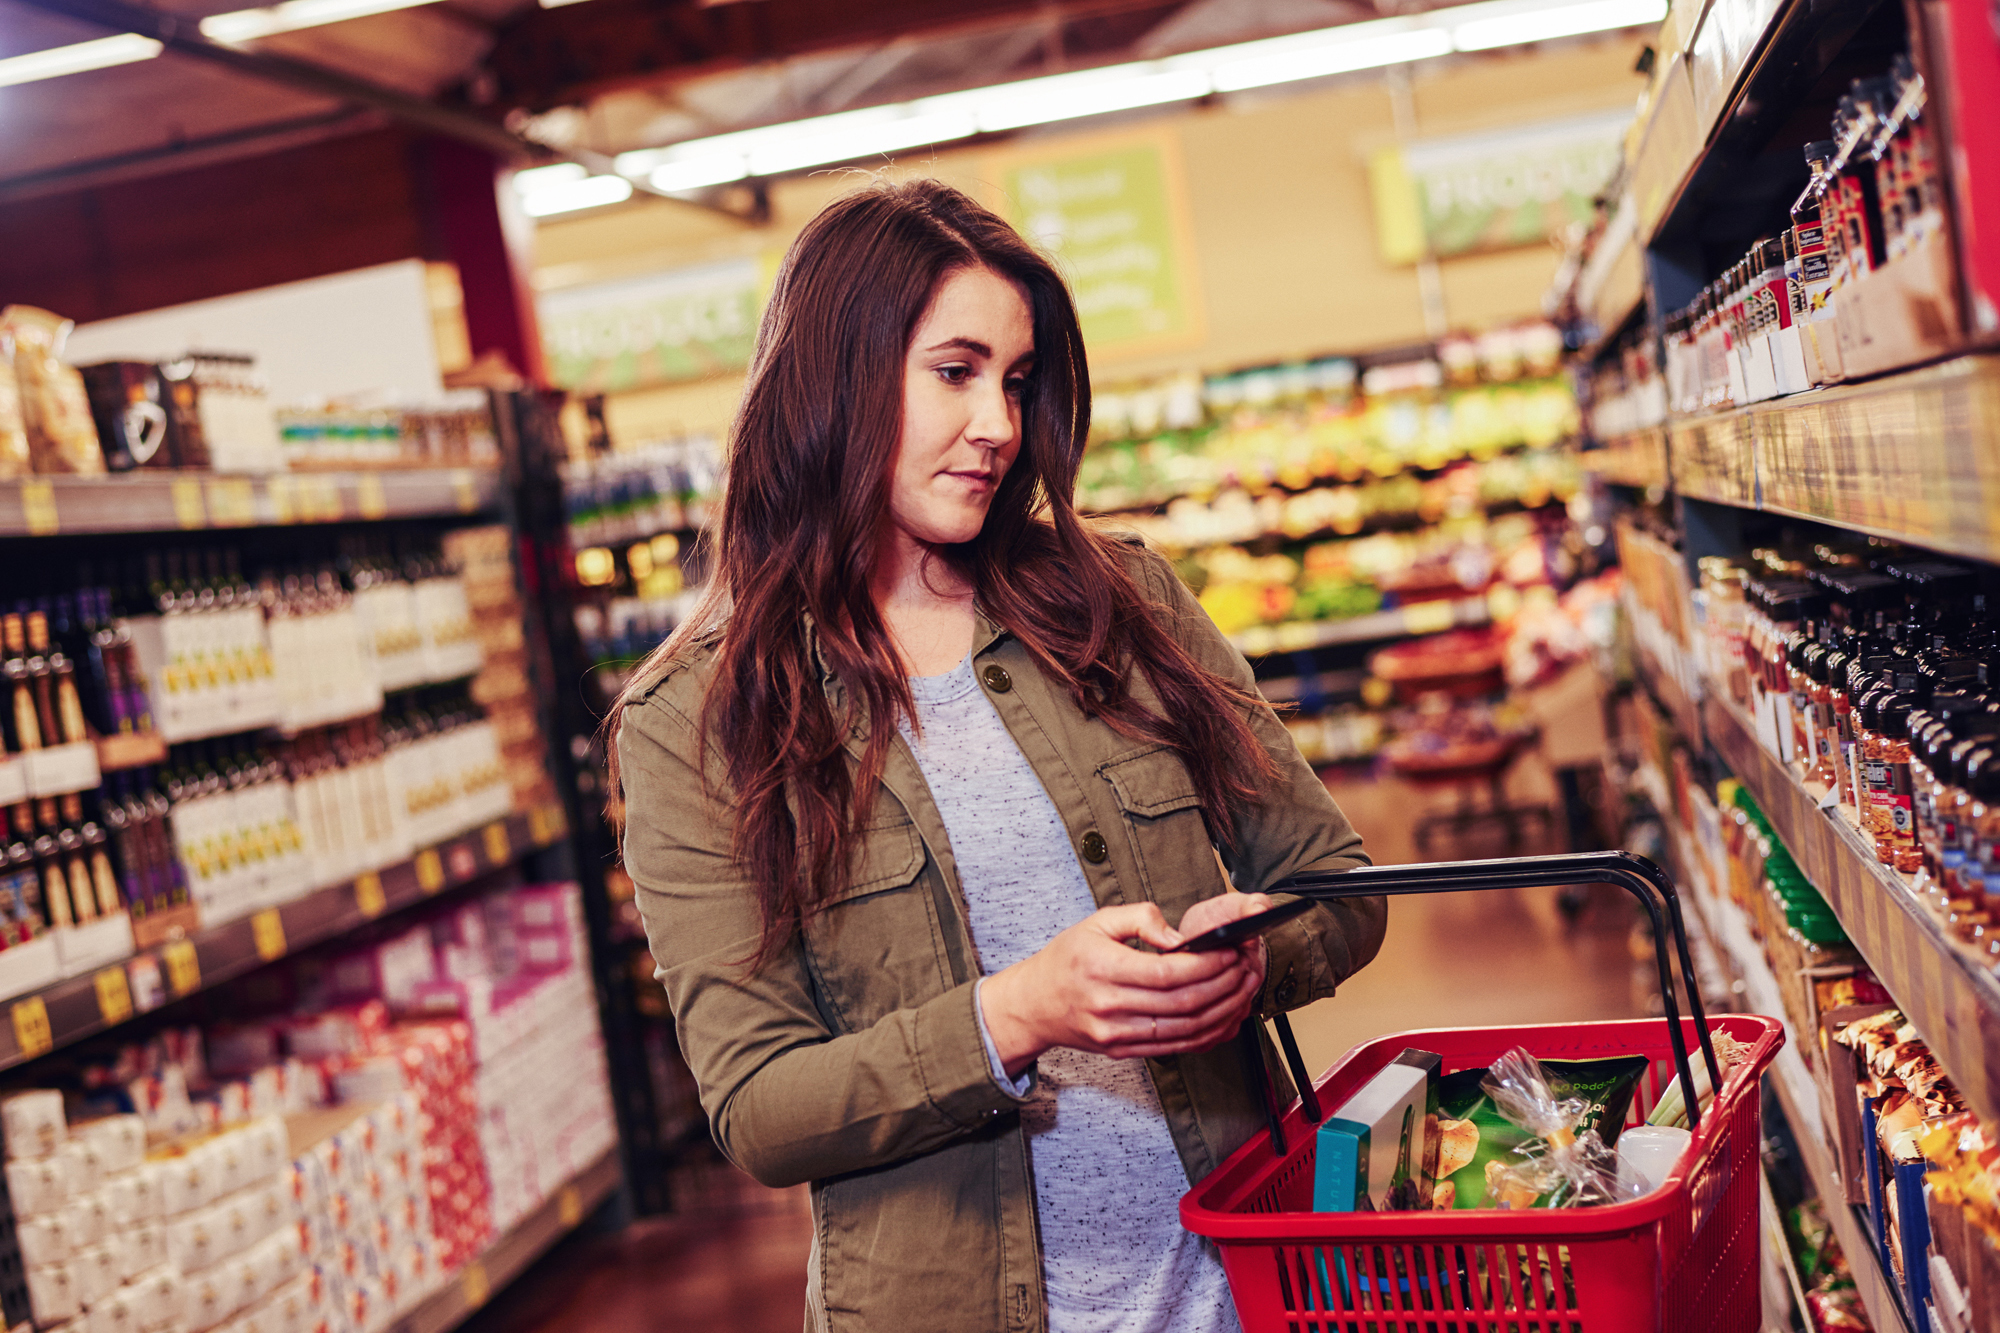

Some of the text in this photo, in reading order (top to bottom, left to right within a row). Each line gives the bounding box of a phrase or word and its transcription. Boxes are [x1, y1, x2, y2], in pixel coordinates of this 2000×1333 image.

[1804, 260, 1827, 272] Vanilla
[1805, 271, 1828, 280] Extract
[1573, 1076, 1616, 1091] popped
[1330, 1150, 1342, 1212] NATUR
